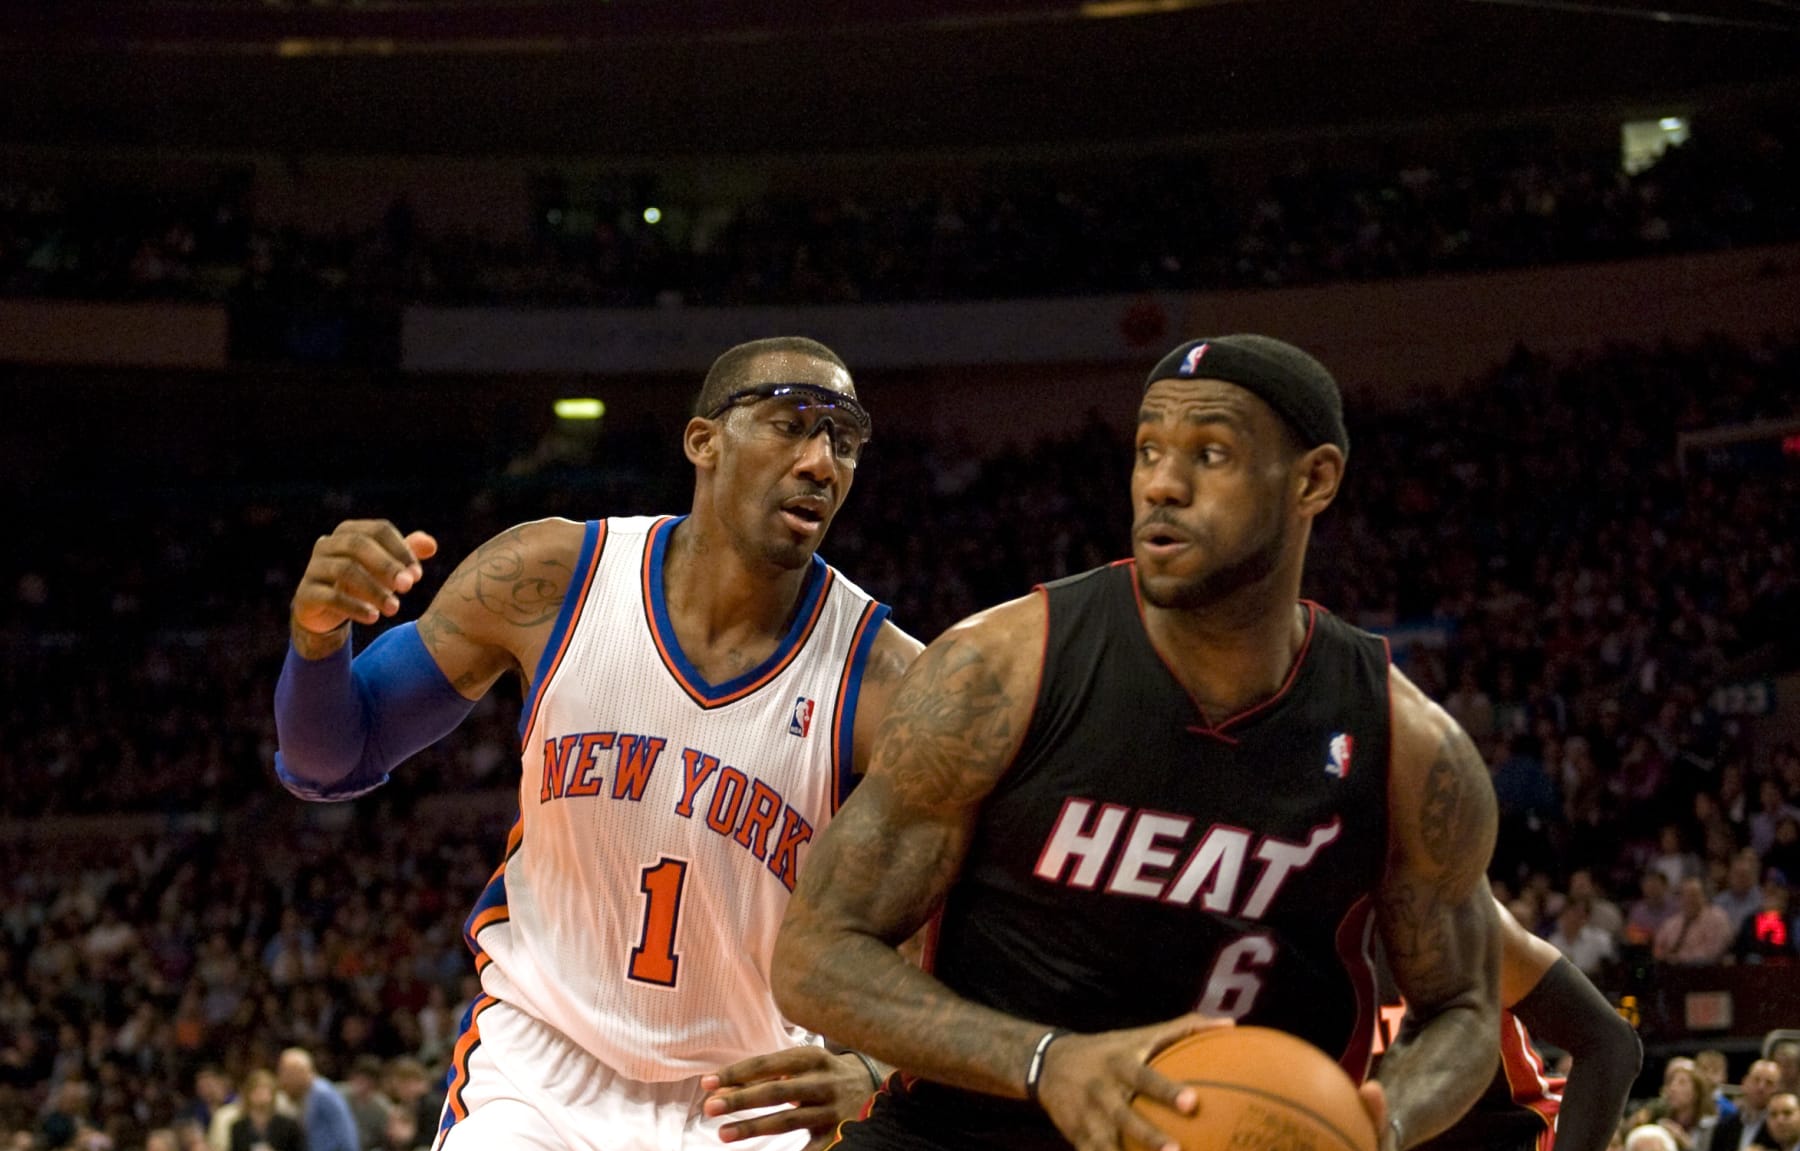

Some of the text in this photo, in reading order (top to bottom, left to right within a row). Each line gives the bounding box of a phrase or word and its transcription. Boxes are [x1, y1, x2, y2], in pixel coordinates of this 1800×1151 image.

[541, 732, 813, 893] NEW YORK
[1033, 798, 1341, 919] HEAT
[627, 856, 688, 988] 1
[1198, 934, 1277, 1021] 6
